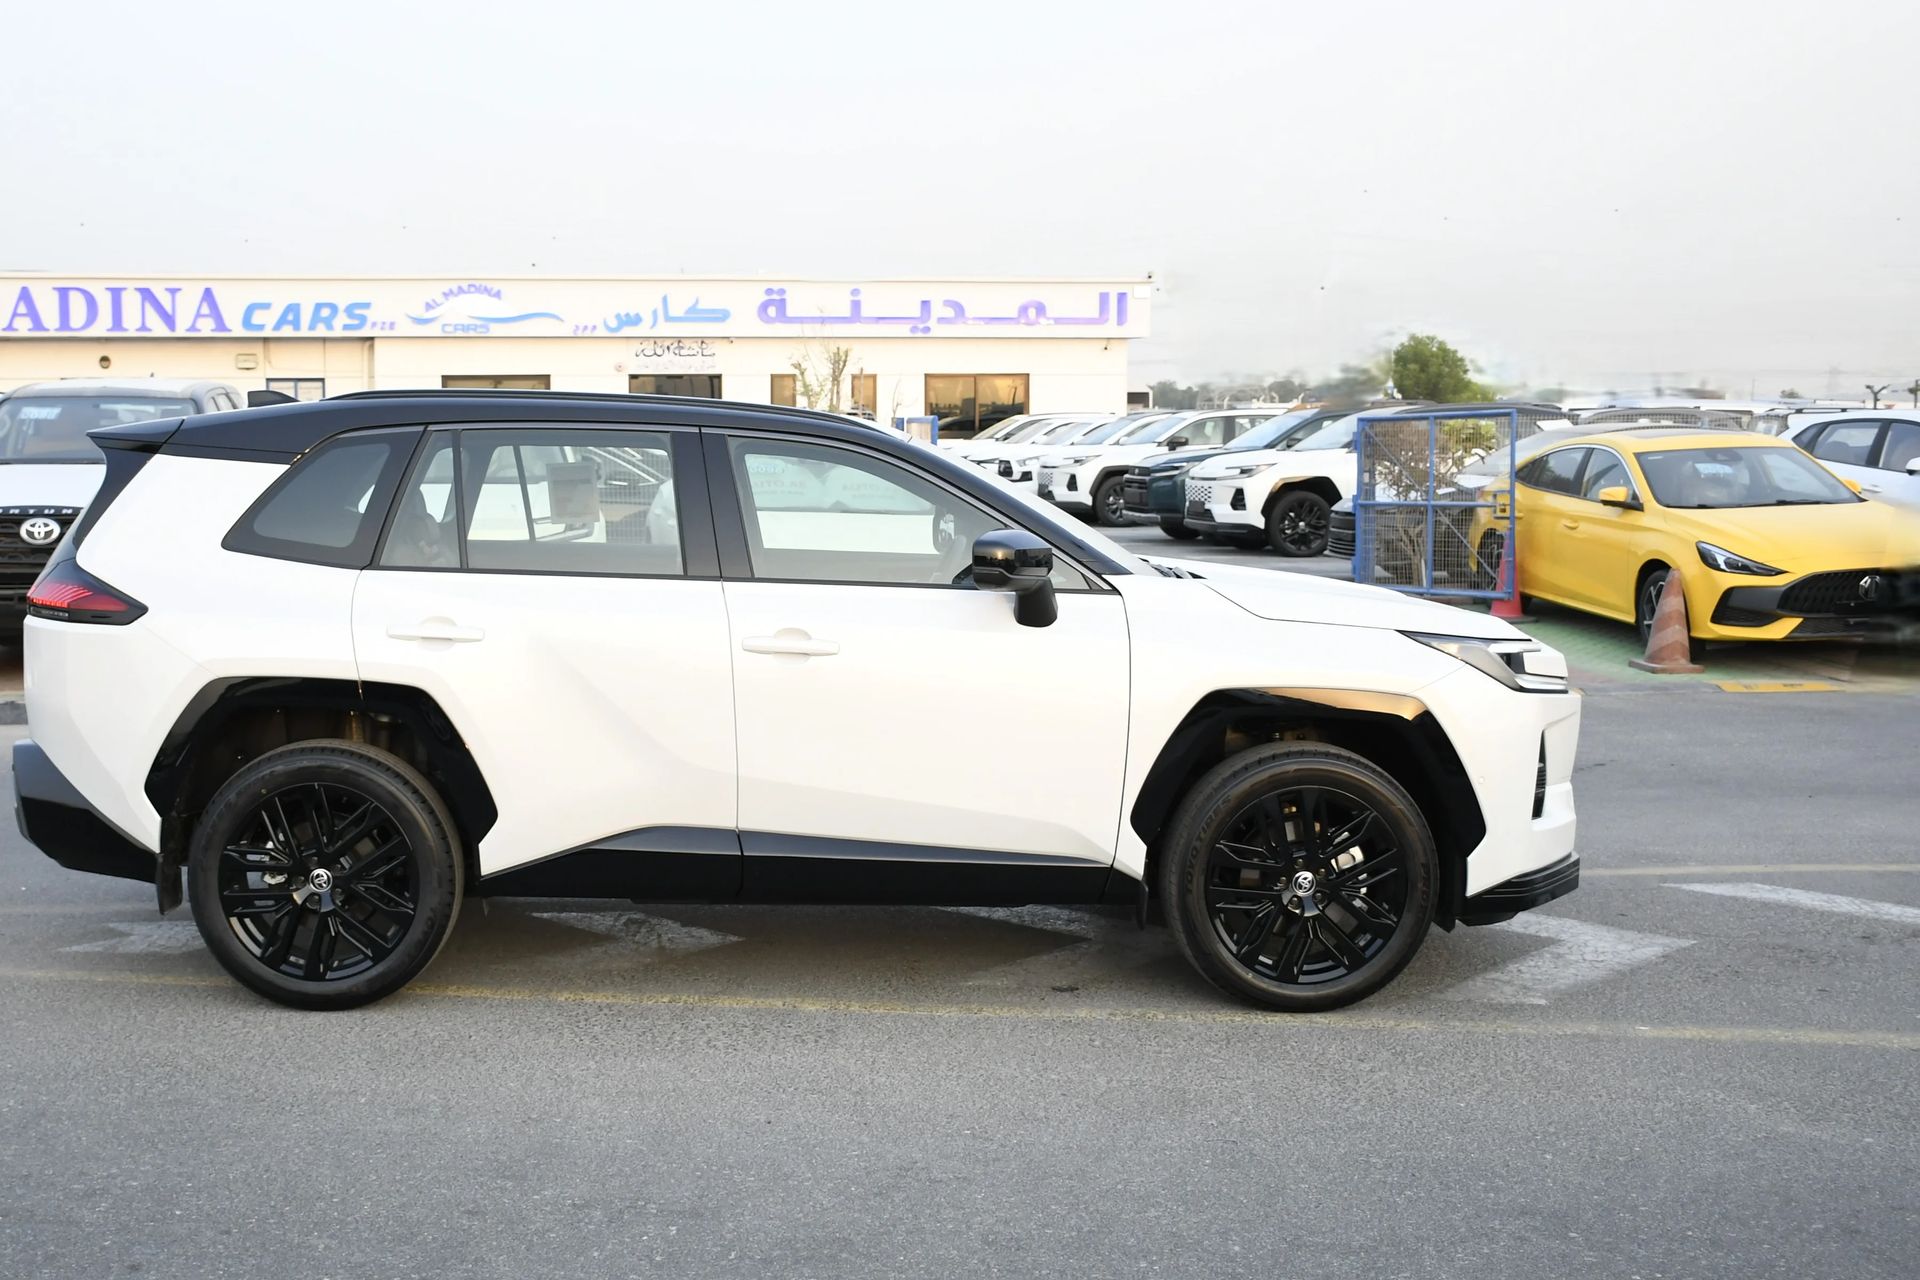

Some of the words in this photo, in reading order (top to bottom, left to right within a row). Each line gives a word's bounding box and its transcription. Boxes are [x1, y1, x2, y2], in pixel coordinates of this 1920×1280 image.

[1, 286, 233, 332] ADINA
[241, 302, 371, 332] CARS
[425, 298, 444, 312] AL
[443, 284, 502, 301] MADINA
[603, 293, 731, 334] كارس
[757, 288, 1128, 334] المدينة
[442, 323, 489, 334] CARS
